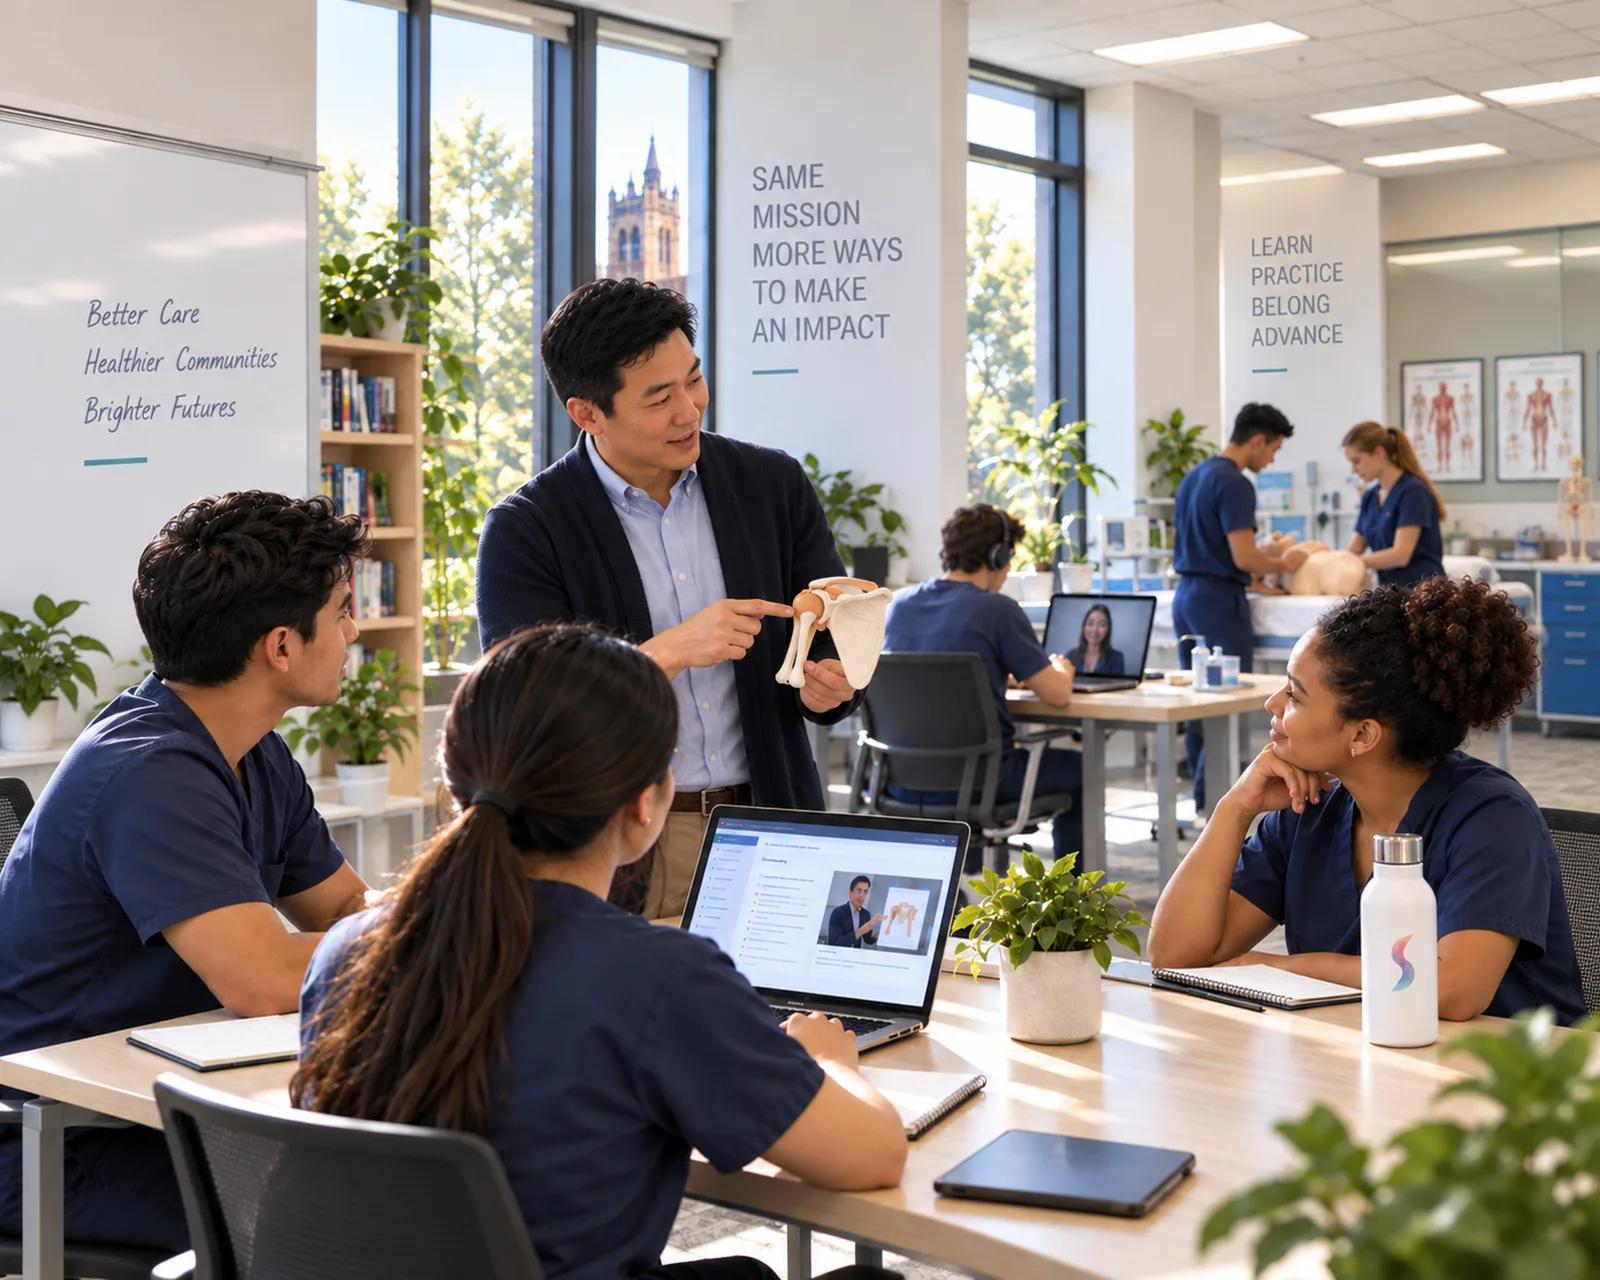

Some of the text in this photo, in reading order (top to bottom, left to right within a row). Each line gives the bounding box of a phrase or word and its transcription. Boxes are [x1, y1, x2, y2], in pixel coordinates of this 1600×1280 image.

[752, 163, 824, 191] SAME
[753, 200, 860, 229] MISSION
[753, 237, 903, 267] MORE WAYS
[1251, 234, 1312, 257] LEARN
[1251, 262, 1343, 286] PRACTICE
[752, 276, 867, 305] TO MAKE
[1252, 293, 1330, 317] BELONG
[87, 298, 200, 328] Better Care
[752, 313, 891, 343] AN IMPACT
[1251, 323, 1343, 347] ADVANCE
[84, 346, 278, 375] Healthier Communities
[84, 394, 236, 433] Brighter Futures
